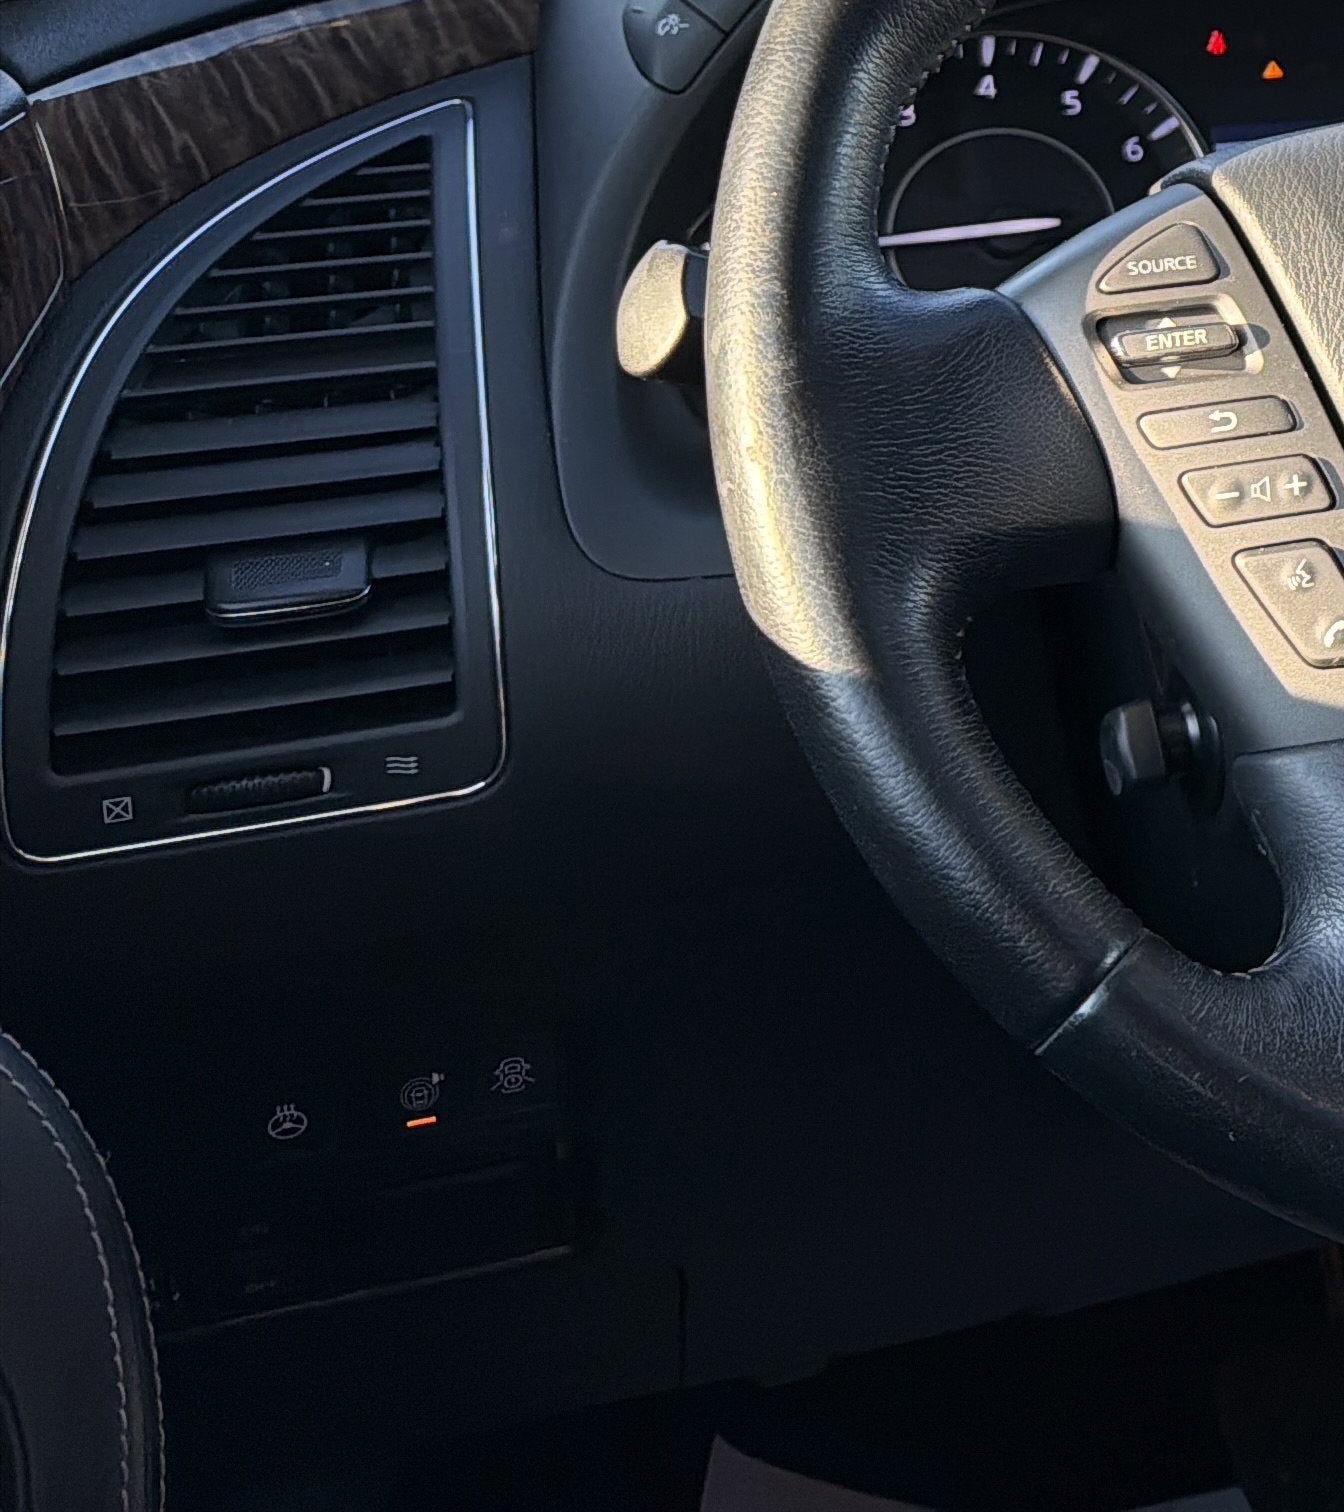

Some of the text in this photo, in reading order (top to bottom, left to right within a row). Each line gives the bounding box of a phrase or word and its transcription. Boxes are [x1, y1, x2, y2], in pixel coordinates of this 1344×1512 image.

[973, 74, 998, 99] 4
[1060, 90, 1083, 116] 5
[1121, 136, 1144, 163] 6
[1127, 254, 1198, 276] SOURCE
[1145, 328, 1208, 352] ENTER
